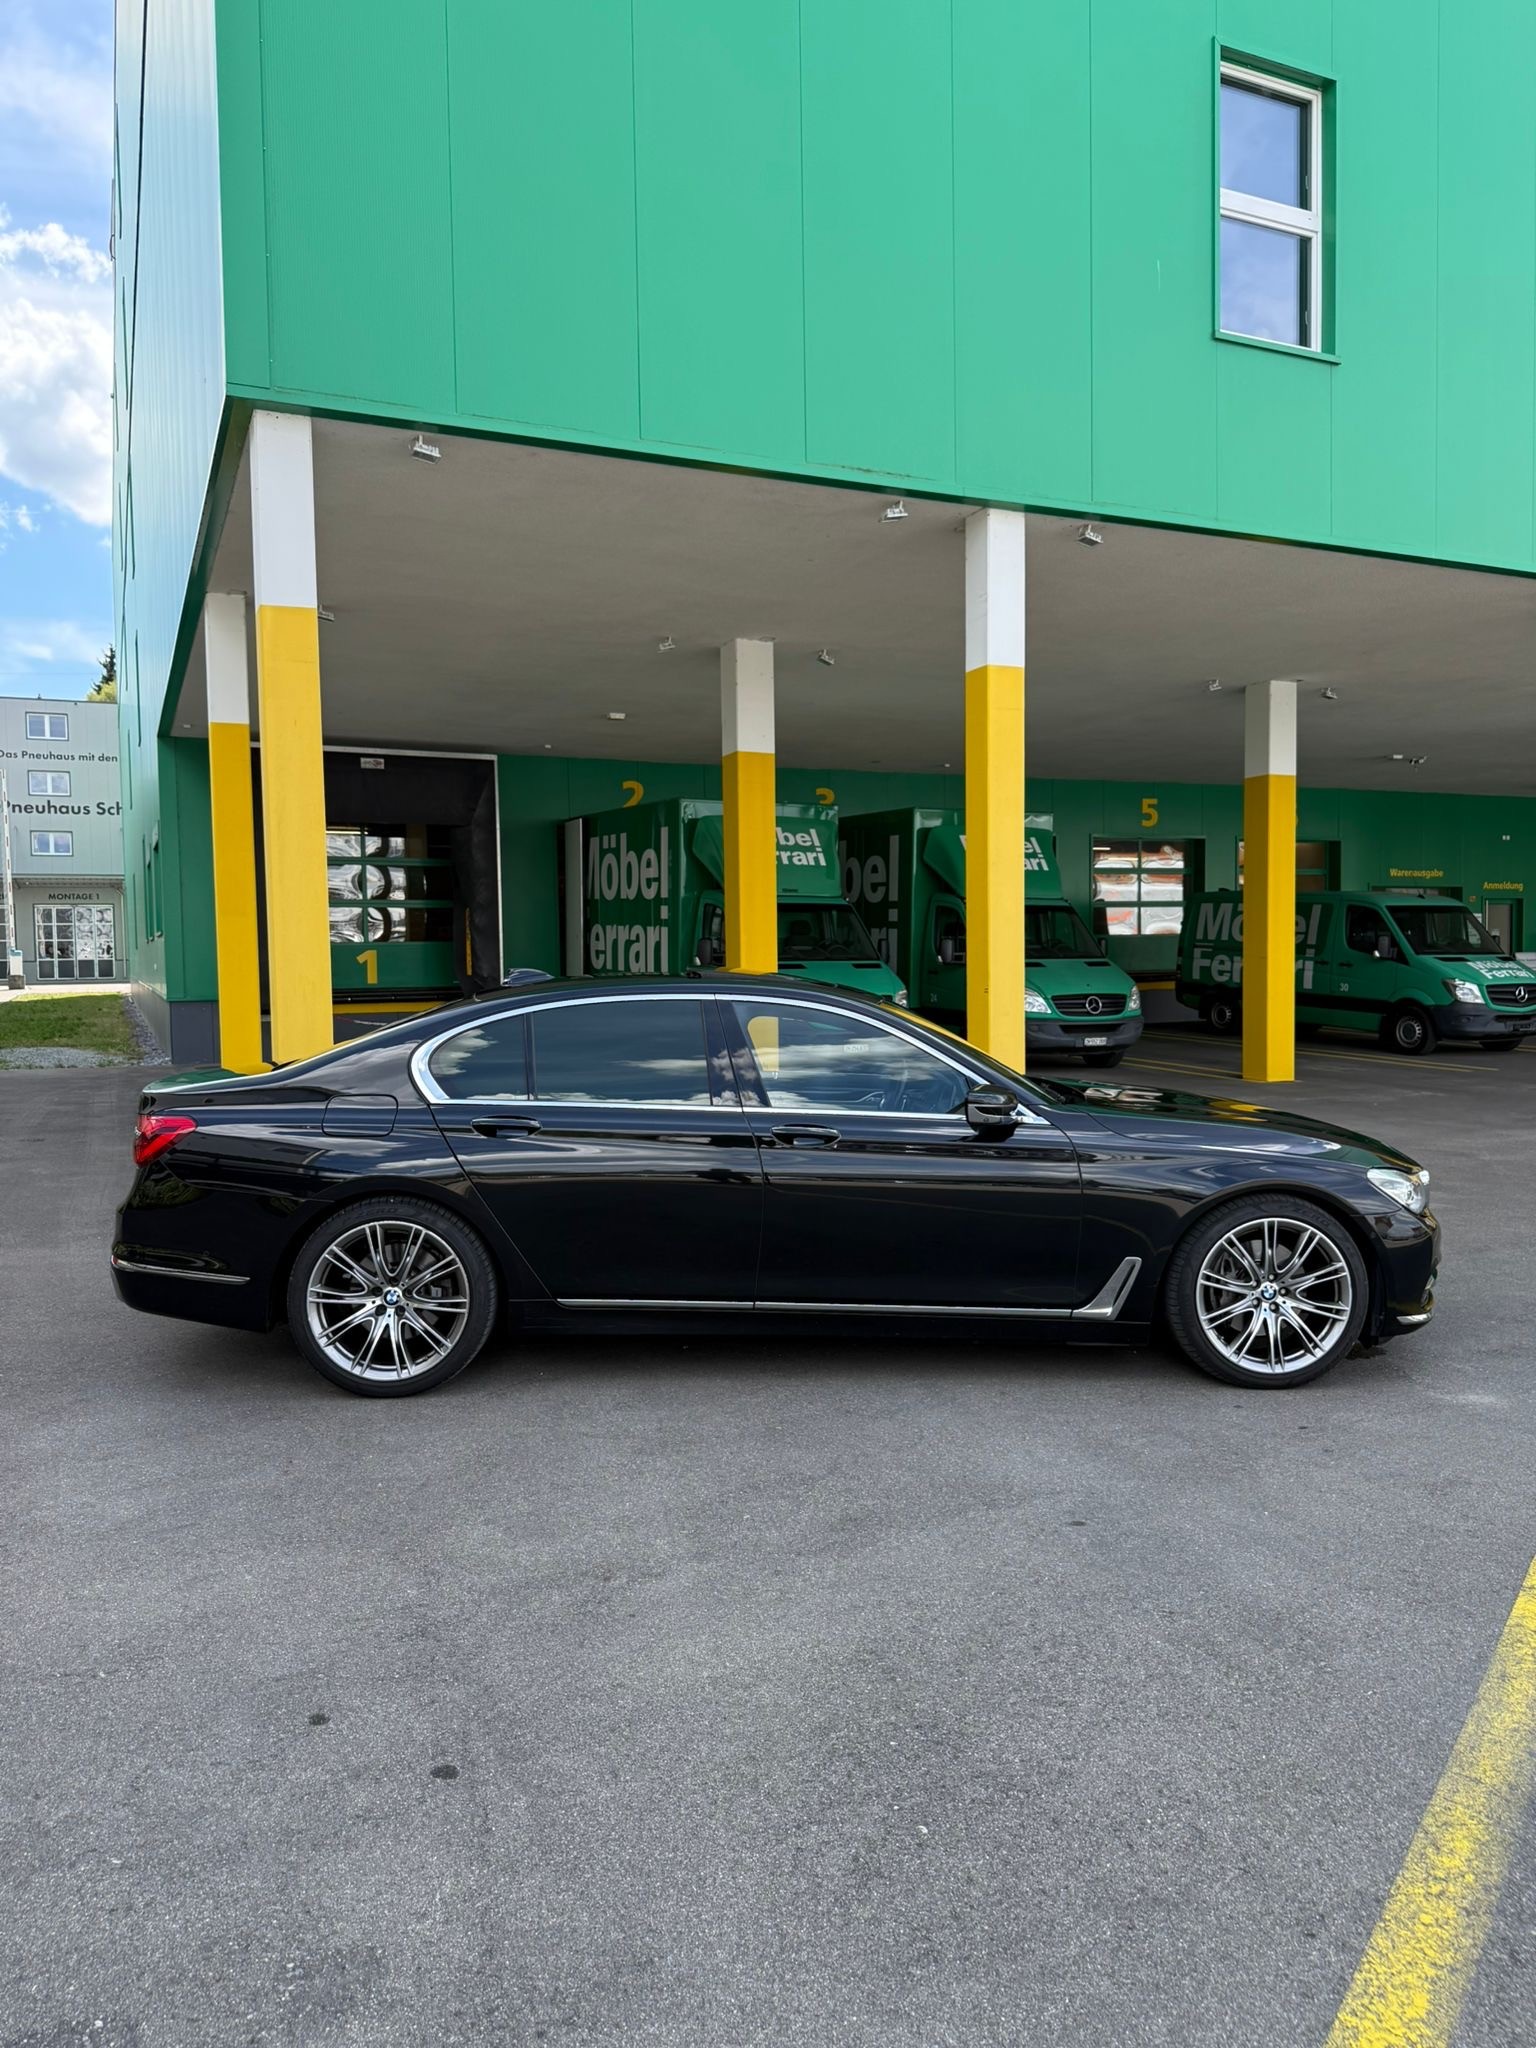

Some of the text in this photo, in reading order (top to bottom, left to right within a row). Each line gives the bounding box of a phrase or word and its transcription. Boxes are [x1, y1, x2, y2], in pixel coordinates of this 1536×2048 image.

[0, 749, 118, 762] Das Pneuhaus mit den
[1140, 798, 1159, 828] 5
[776, 827, 821, 847] bel
[776, 847, 827, 866] rari
[840, 835, 899, 904] bel
[1389, 868, 1444, 879] Warenausgabe
[1483, 881, 1523, 892] Anmeldung
[589, 905, 669, 976] errari
[356, 949, 378, 984] 1
[1339, 982, 1349, 992] 30
